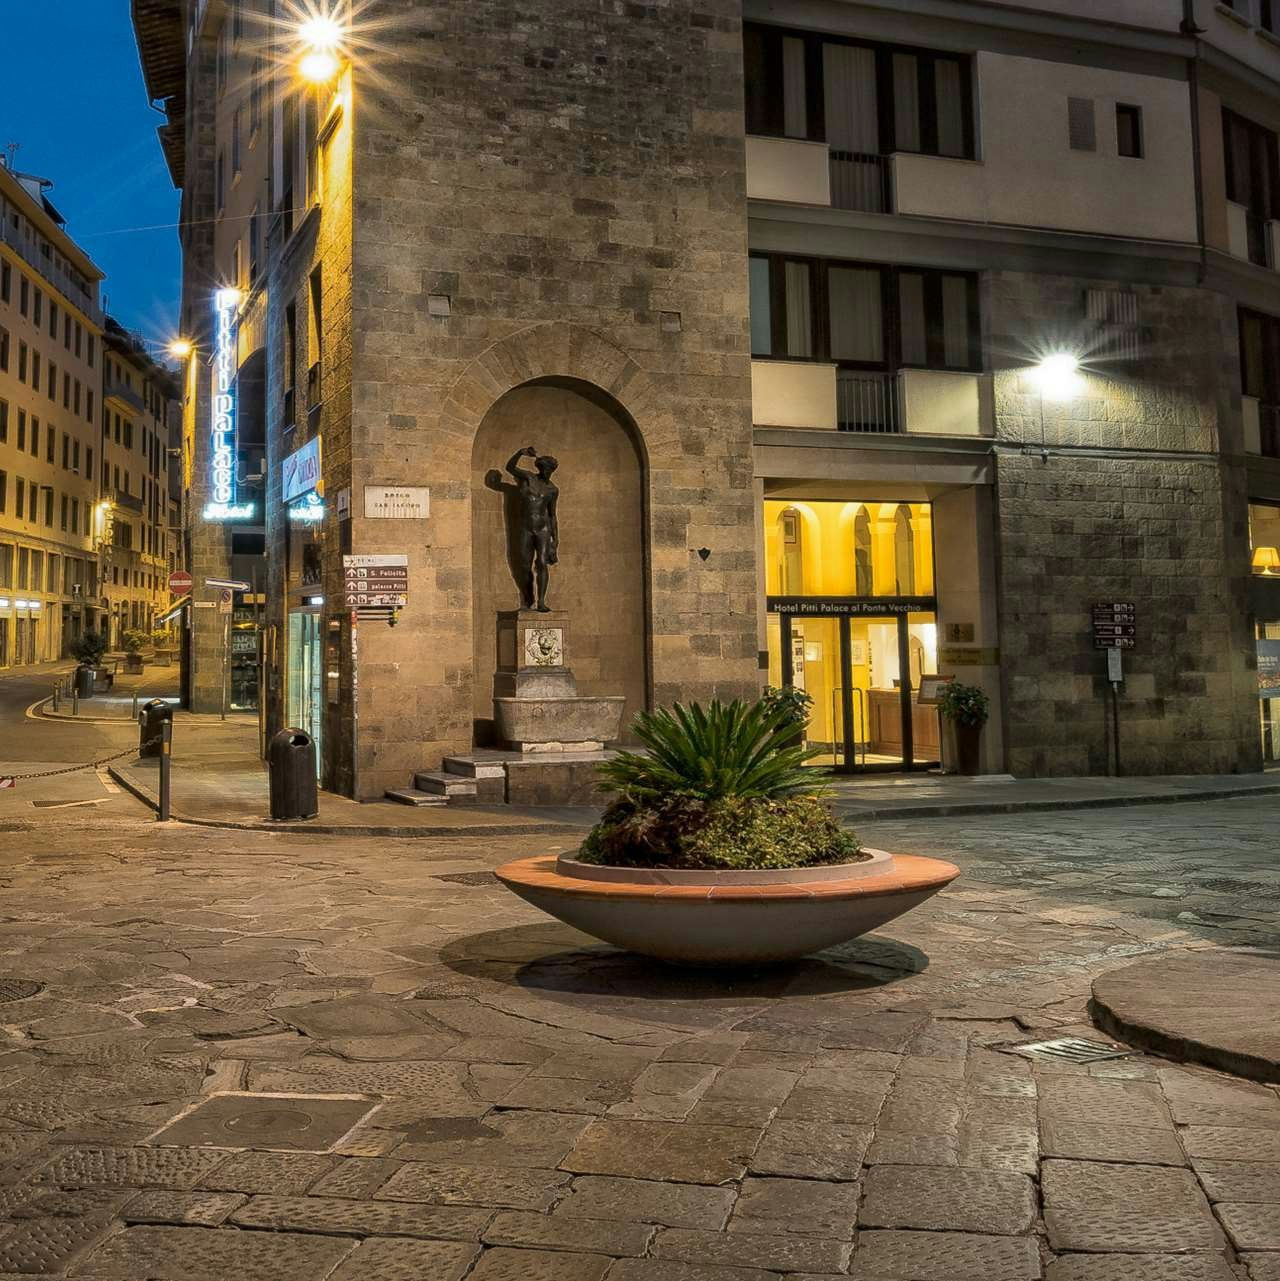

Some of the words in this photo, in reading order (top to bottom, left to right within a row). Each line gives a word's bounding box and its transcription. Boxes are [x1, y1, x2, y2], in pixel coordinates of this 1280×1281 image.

[774, 603, 799, 612] Hotel
[801, 603, 818, 612] Pitti
[820, 603, 849, 612] Palace
[851, 603, 860, 612] al
[862, 603, 886, 612] Ponte
[888, 603, 921, 612] Vecchio
